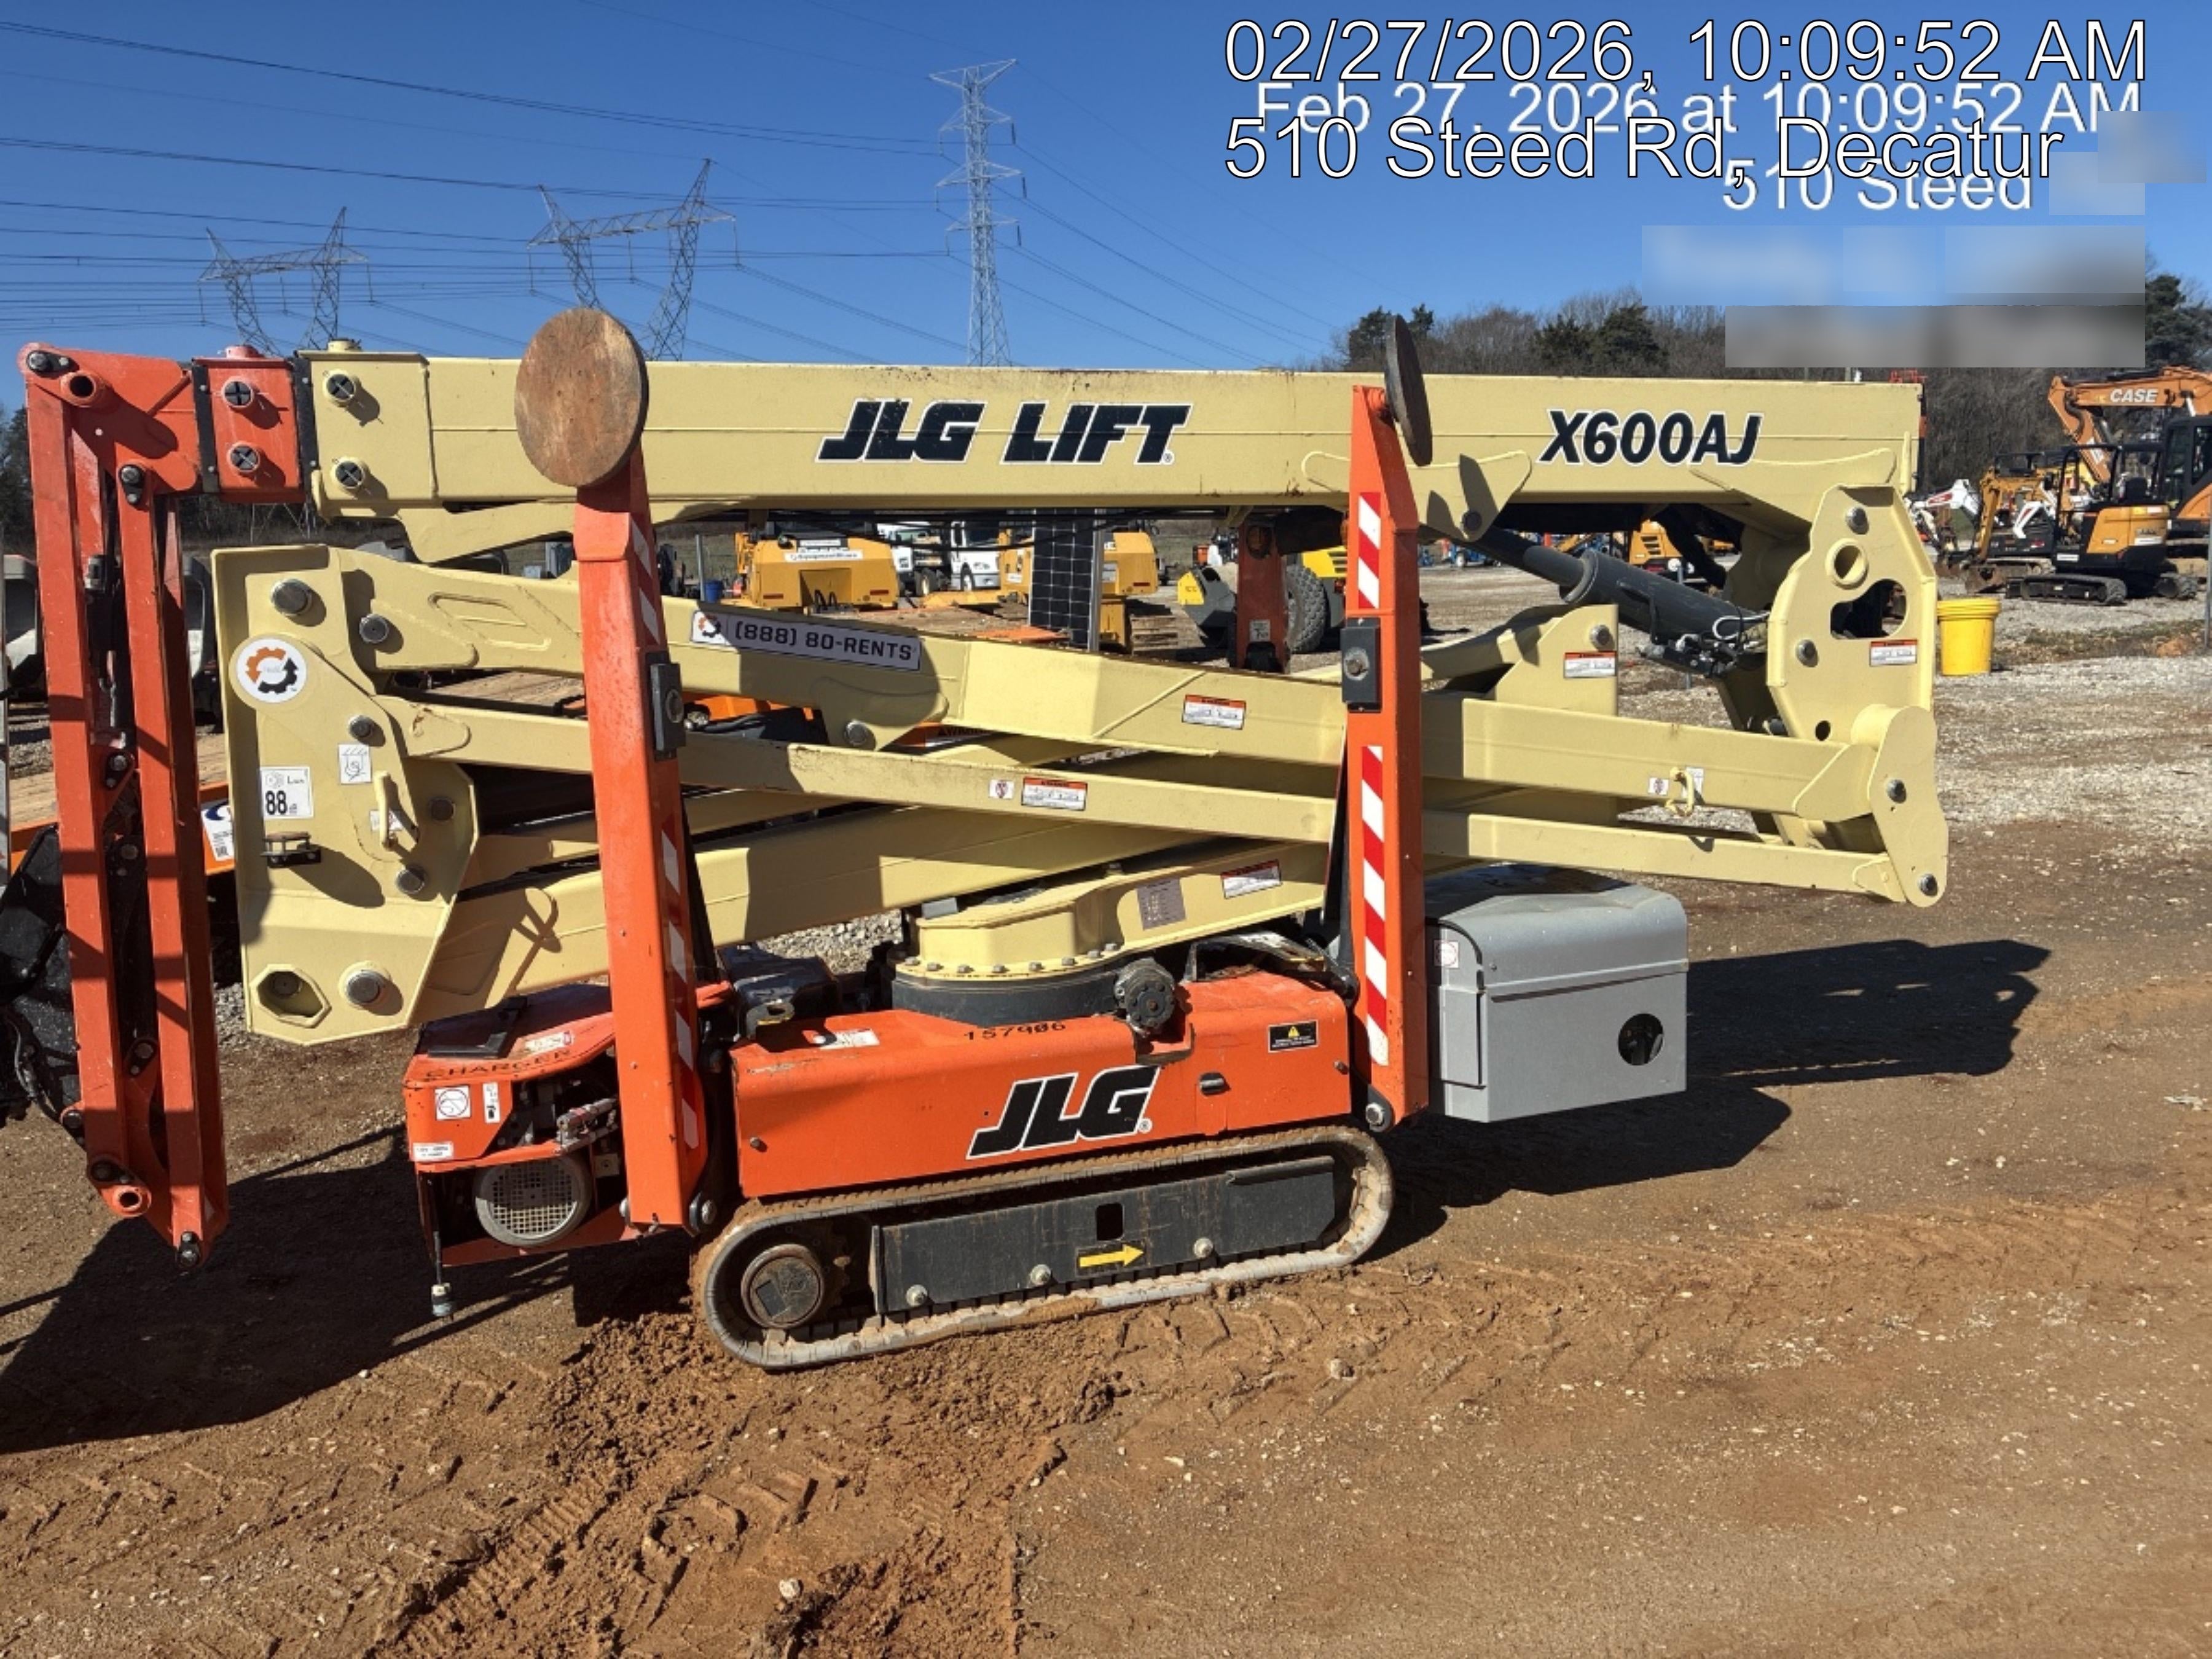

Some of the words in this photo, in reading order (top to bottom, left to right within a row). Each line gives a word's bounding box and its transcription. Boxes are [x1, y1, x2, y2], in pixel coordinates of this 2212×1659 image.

[2110, 388, 2159, 402] CASE
[815, 399, 986, 463] JLG
[1000, 402, 1192, 465] LIFT
[1537, 410, 1763, 465] X600AJ
[735, 623, 798, 646] (888)
[805, 630, 912, 661] 80-RENTS
[265, 790, 288, 815] 88
[966, 1064, 1161, 1159] JLG
